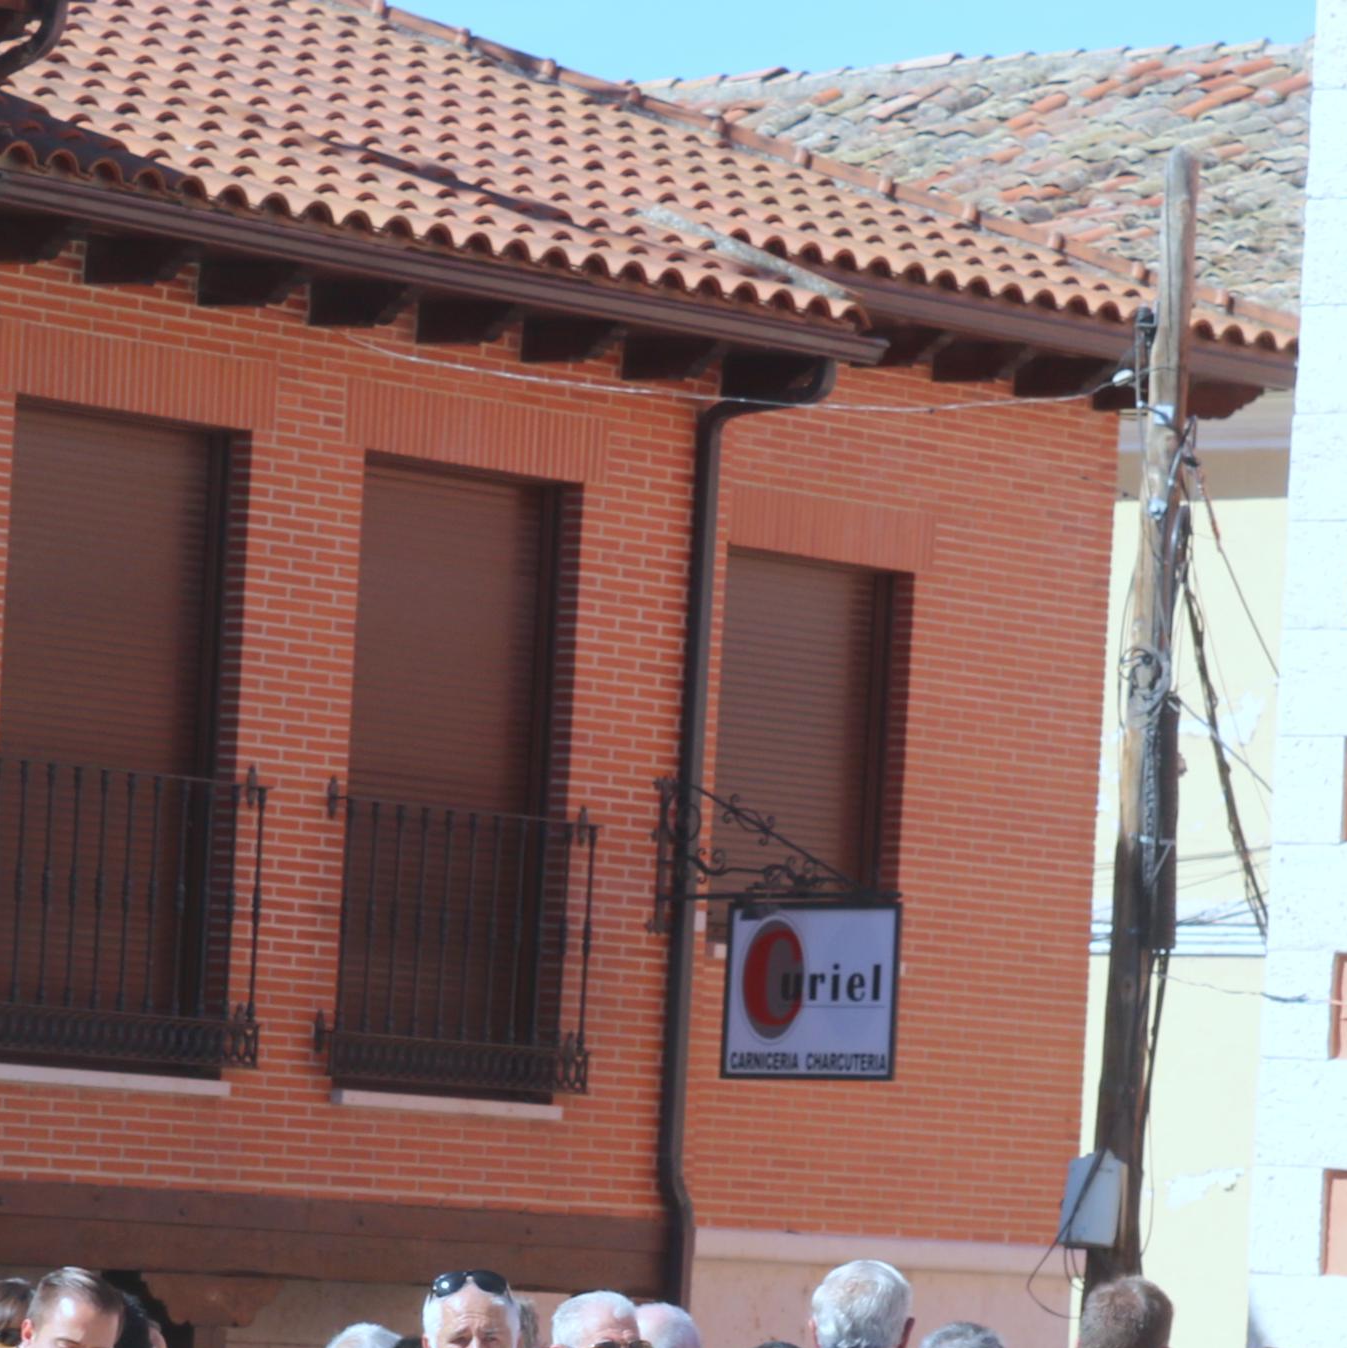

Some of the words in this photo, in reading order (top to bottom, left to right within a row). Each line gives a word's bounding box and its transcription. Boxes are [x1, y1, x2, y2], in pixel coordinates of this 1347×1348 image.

[743, 928, 882, 1028] Curiel
[730, 1052, 799, 1071] CARNICERIA
[806, 1052, 886, 1072] CHARCUTERIA
